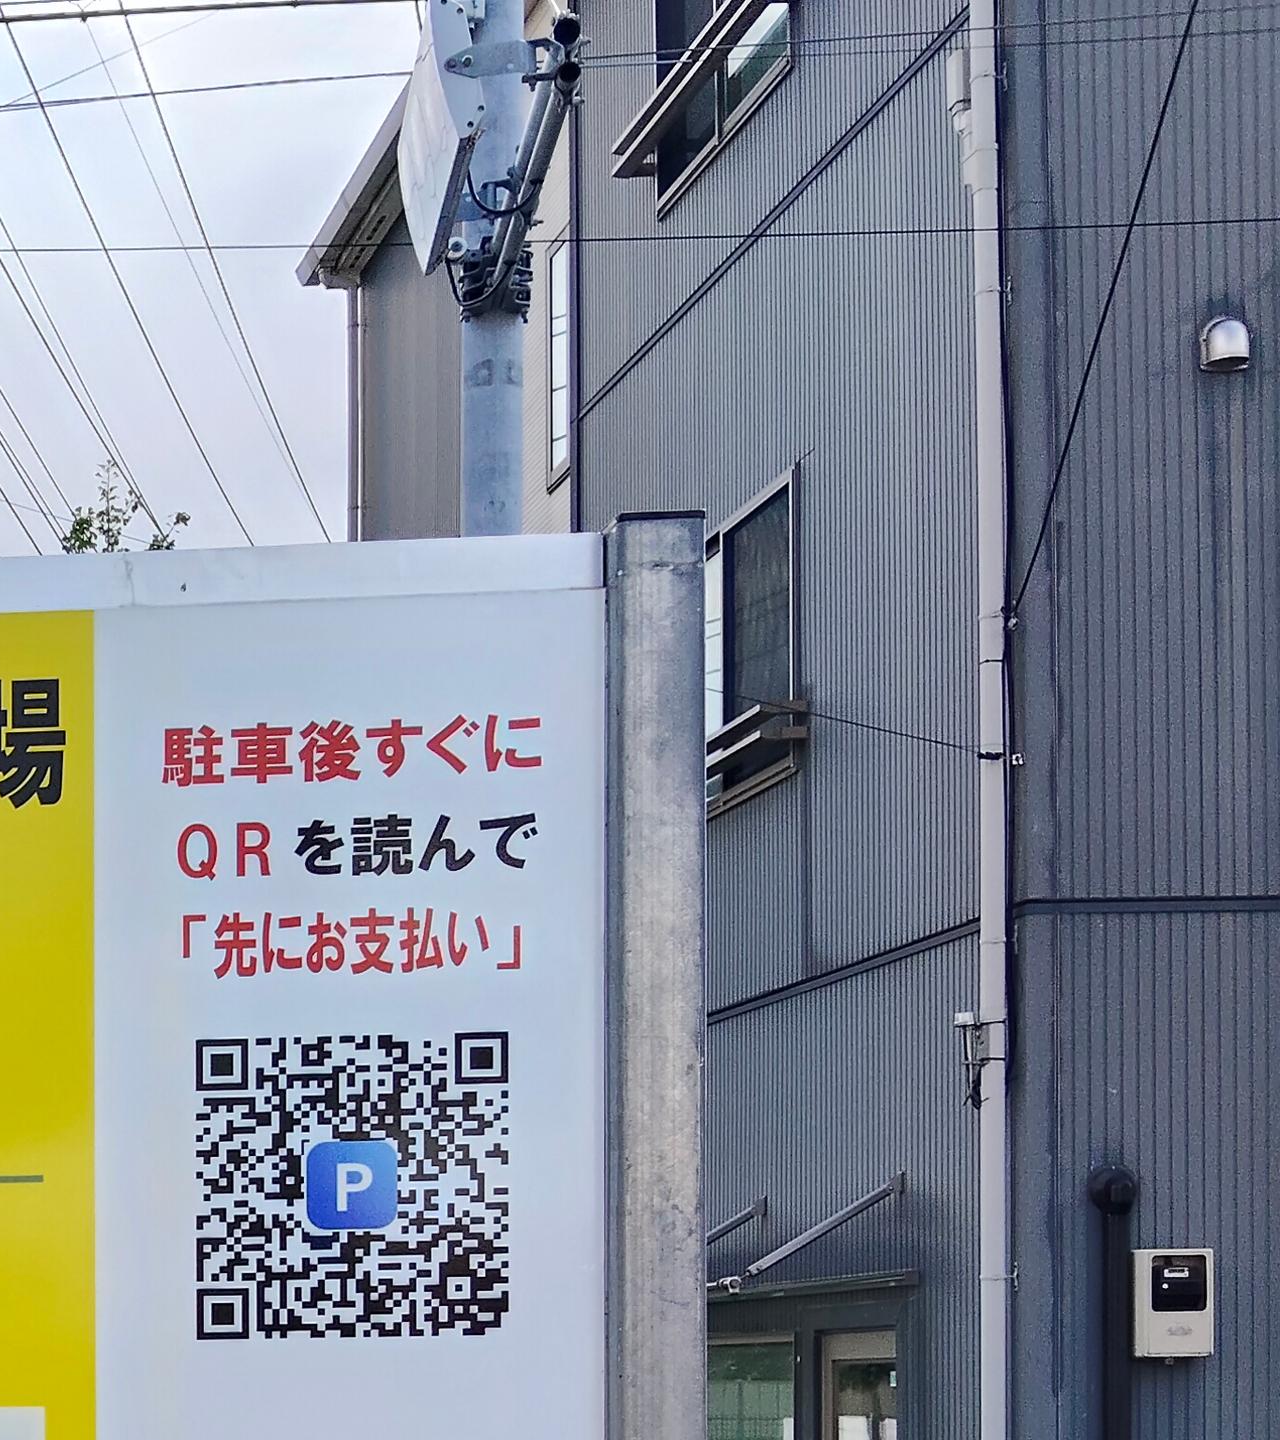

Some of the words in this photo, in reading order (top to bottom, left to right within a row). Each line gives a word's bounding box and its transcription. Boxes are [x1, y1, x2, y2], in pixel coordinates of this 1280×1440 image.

[162, 715, 541, 787] 駐車後すぐに
[183, 908, 520, 979] 「先にお支払い」
[337, 1163, 373, 1211] P
